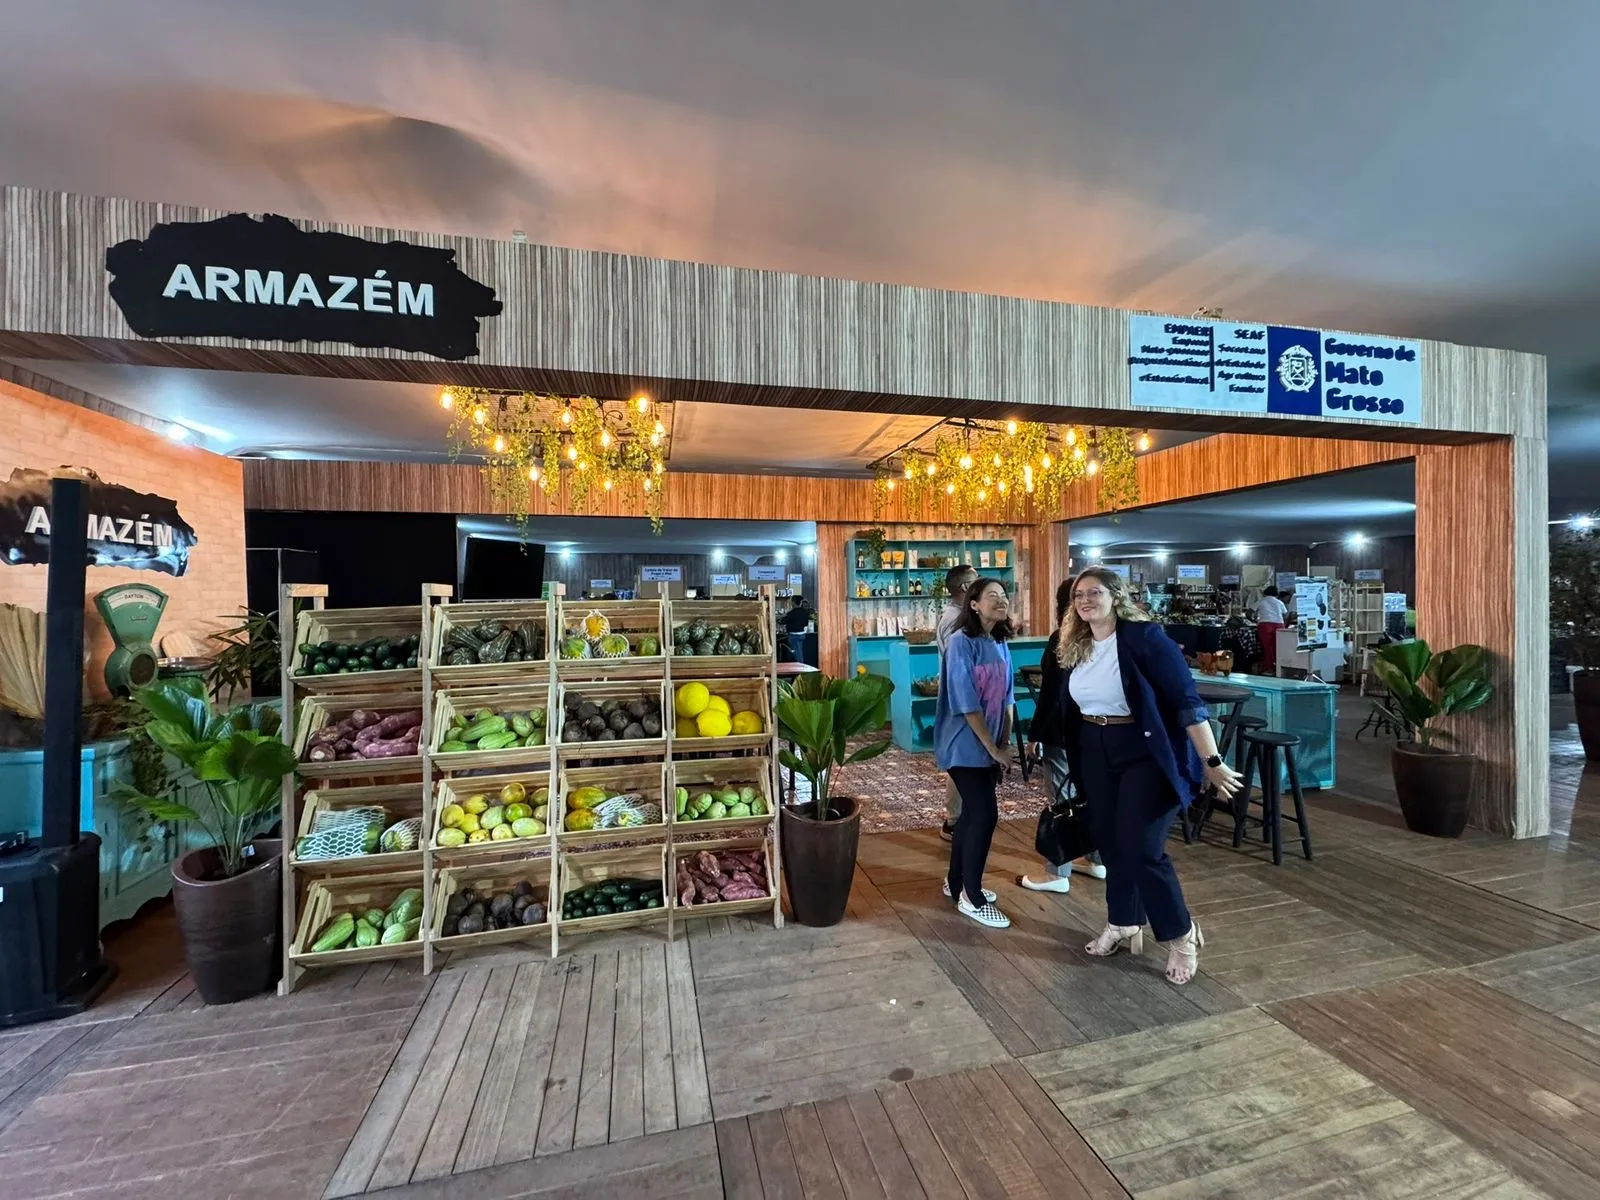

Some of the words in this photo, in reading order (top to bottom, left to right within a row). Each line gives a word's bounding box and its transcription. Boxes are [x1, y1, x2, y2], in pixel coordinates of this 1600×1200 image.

[162, 263, 434, 317] ARMAZÉM
[1234, 329, 1265, 340] SEAF
[1325, 338, 1393, 360] Governo
[1394, 345, 1416, 362] de
[1325, 361, 1384, 387] Mato
[1326, 387, 1404, 415] Grosso
[25, 506, 173, 547] AMAZÉM
